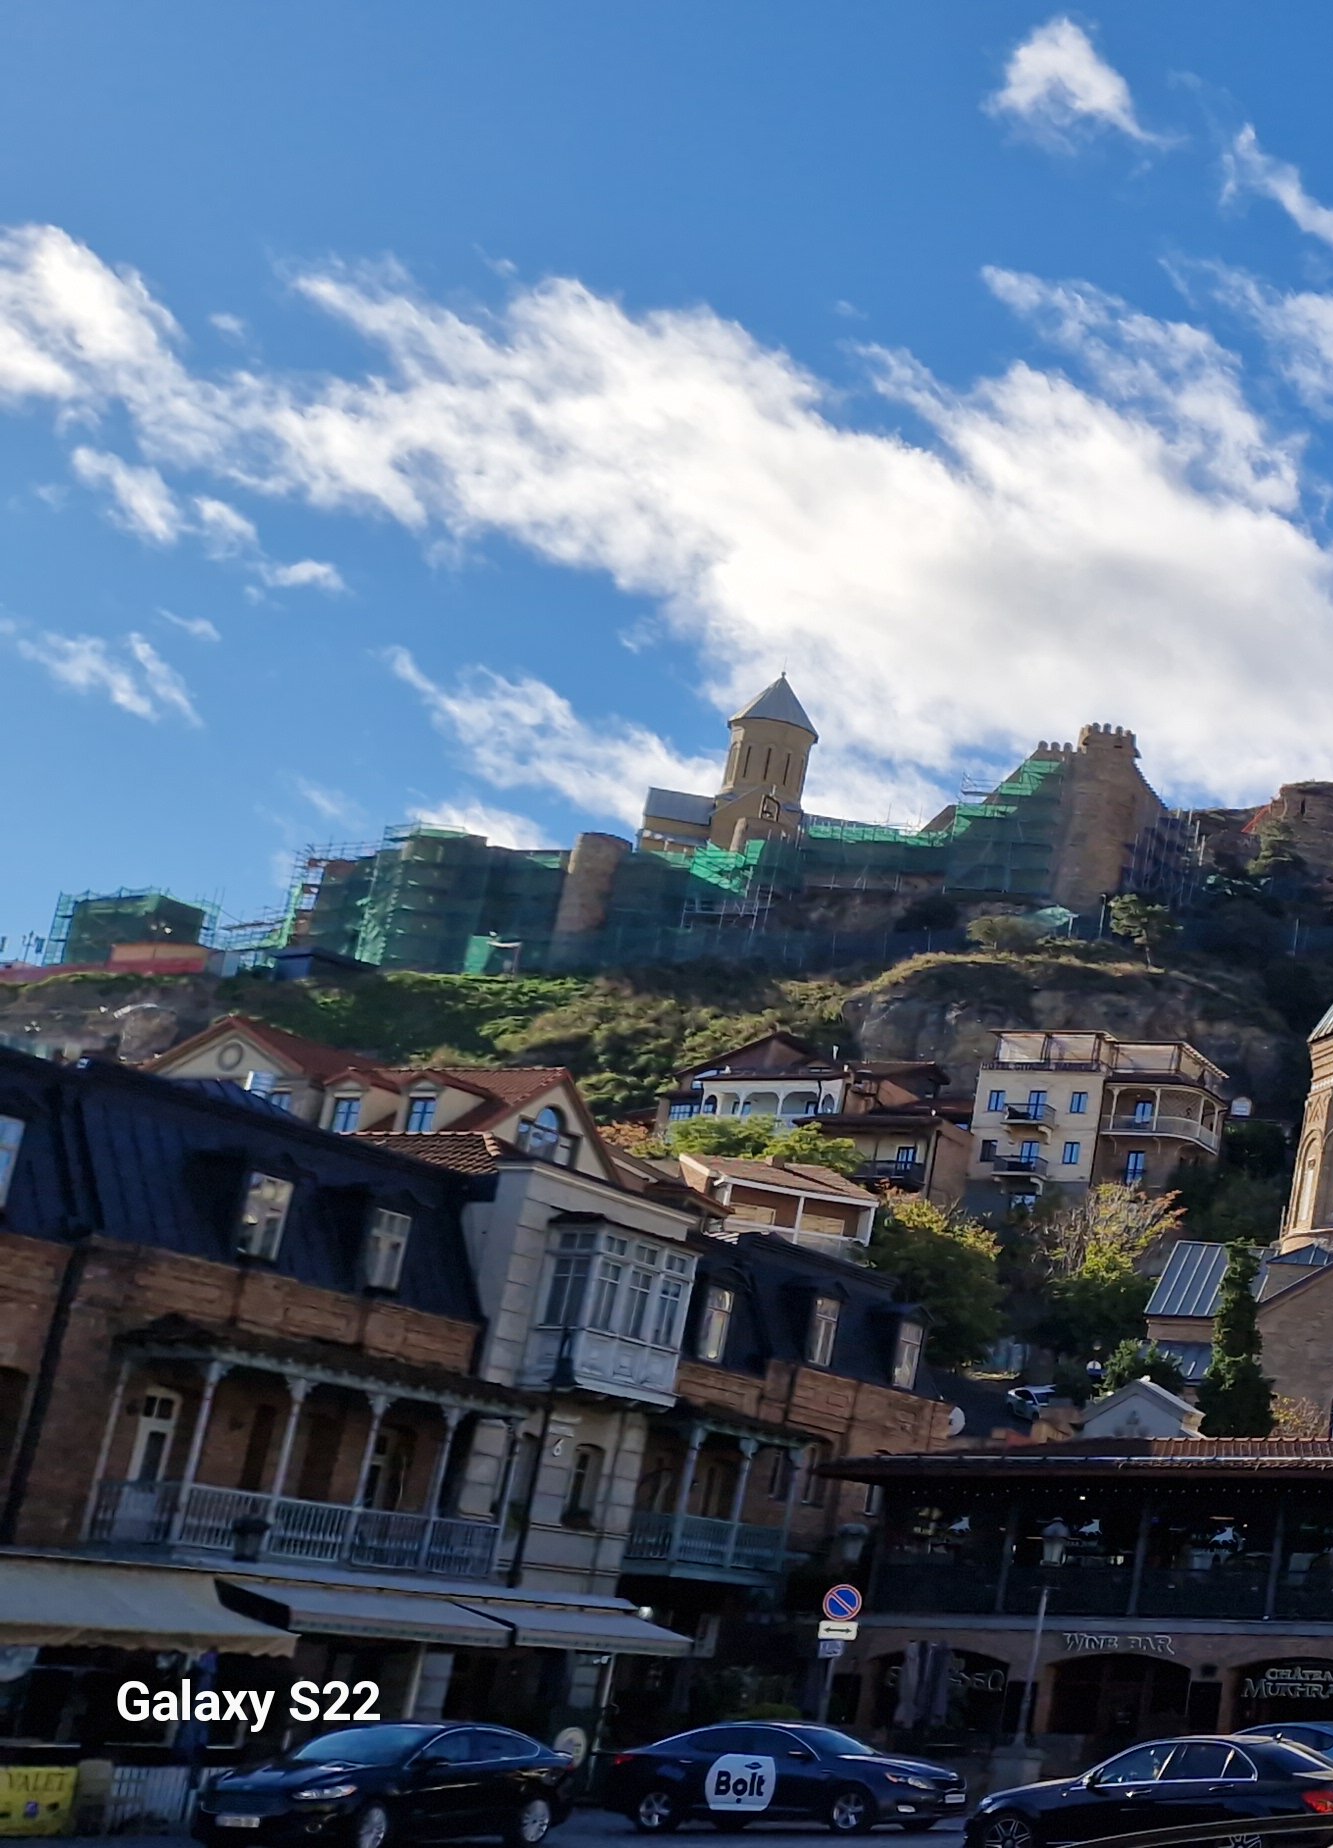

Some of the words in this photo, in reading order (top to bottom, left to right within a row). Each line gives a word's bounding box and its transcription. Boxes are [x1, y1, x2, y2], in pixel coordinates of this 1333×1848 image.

[1063, 1632, 1119, 1653] WINE
[1128, 1634, 1176, 1656] BAR
[7, 1772, 67, 1793] VALET
[714, 1770, 766, 1803] Bolt
